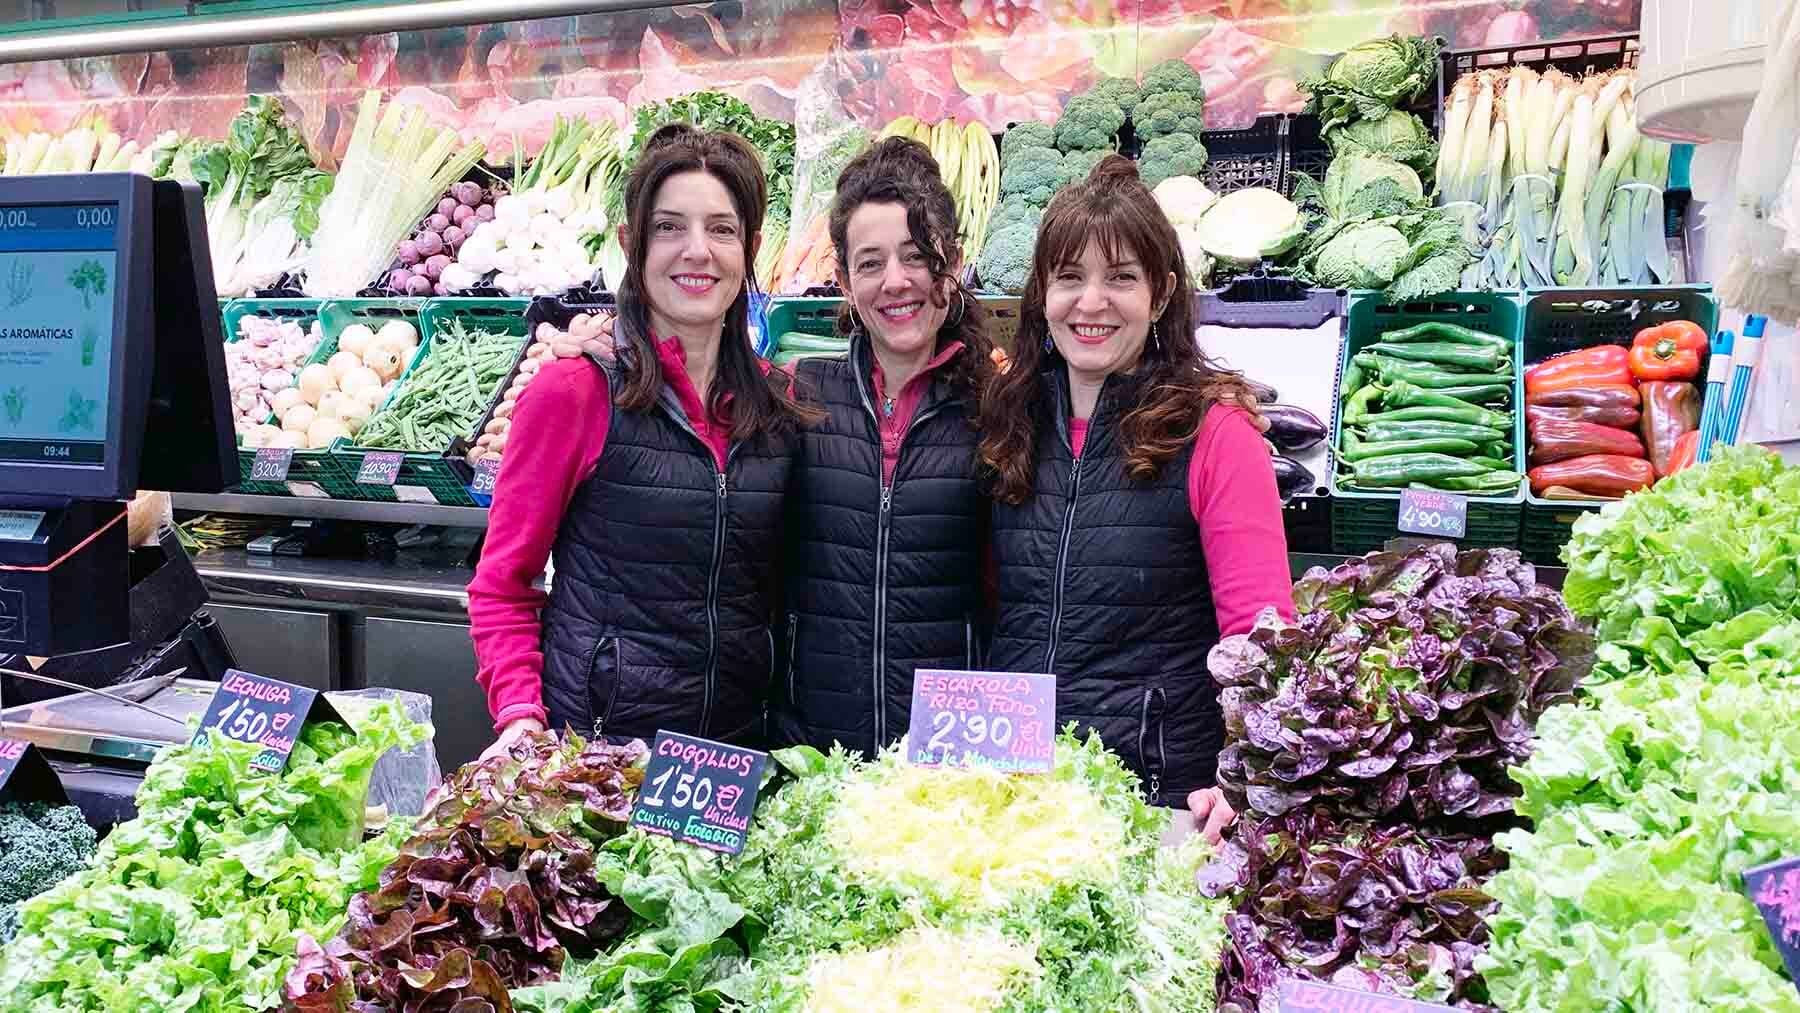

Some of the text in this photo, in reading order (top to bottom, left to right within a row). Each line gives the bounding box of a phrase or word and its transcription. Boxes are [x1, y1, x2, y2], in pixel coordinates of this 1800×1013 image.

[10, 325, 73, 339] AROMÁTICAS
[43, 446, 70, 457] 09:44
[222, 673, 292, 704] LECHUGA
[919, 675, 1032, 695] ESCAROLA
[927, 710, 1013, 751] 2'90
[657, 738, 754, 777] COGOLLOS
[643, 764, 713, 811] 1'50
[703, 805, 749, 830] Unidad
